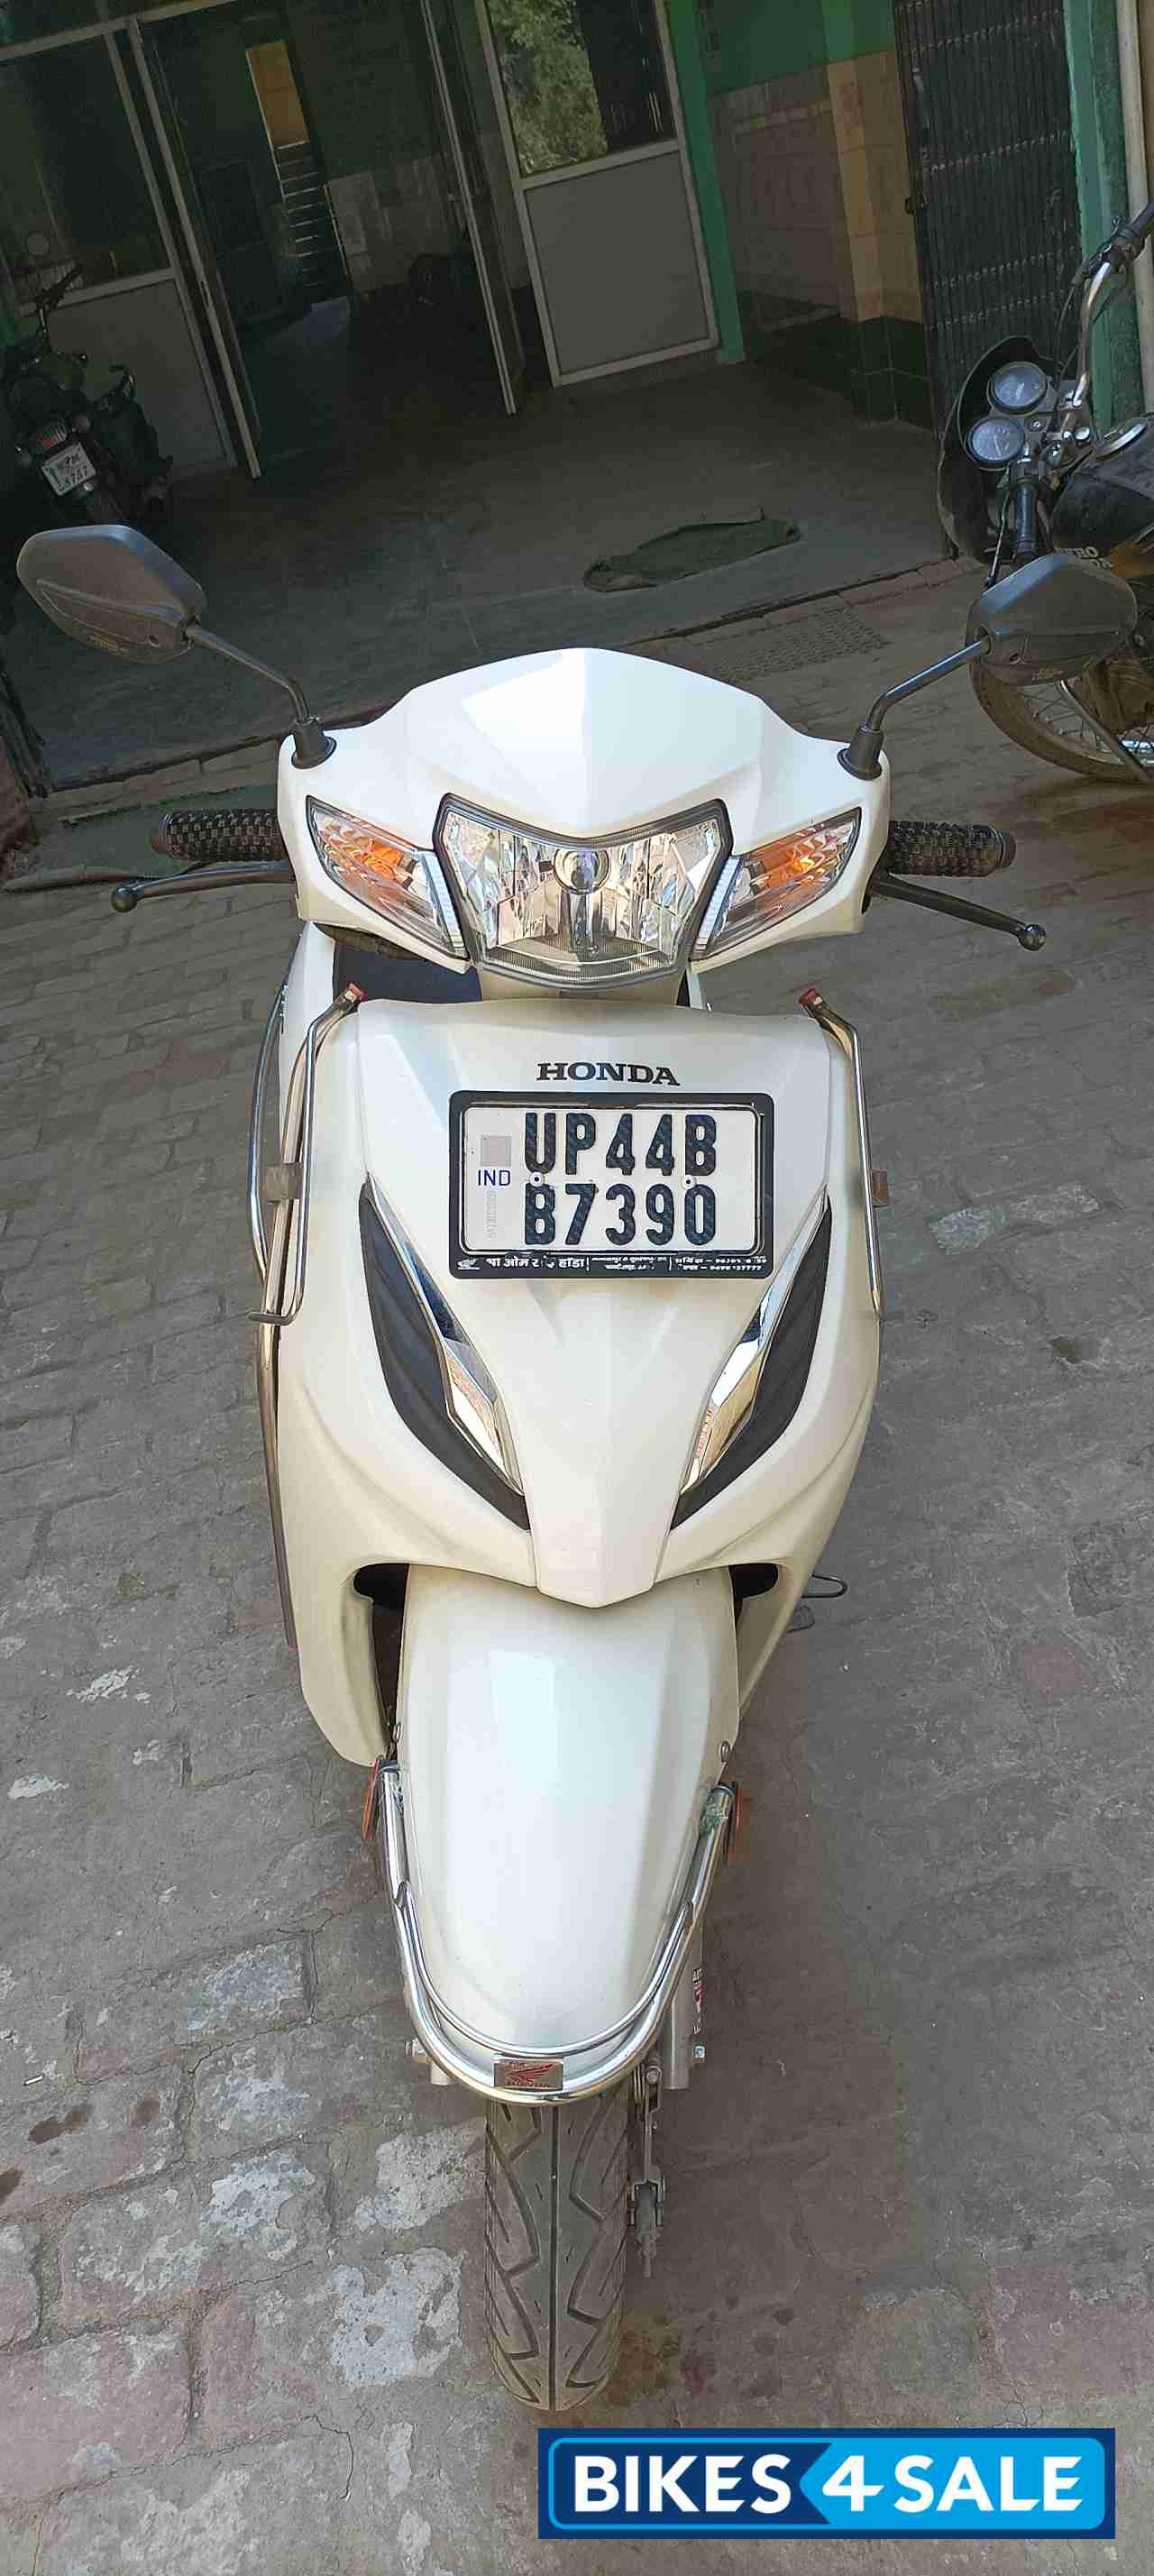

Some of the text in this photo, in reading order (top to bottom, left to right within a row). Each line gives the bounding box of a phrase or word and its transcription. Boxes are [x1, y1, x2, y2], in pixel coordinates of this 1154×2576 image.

[536, 1061, 681, 1086] HONDA
[525, 1112, 717, 1176] UP44B
[478, 1169, 511, 1187] IND
[525, 1183, 717, 1246] B7390
